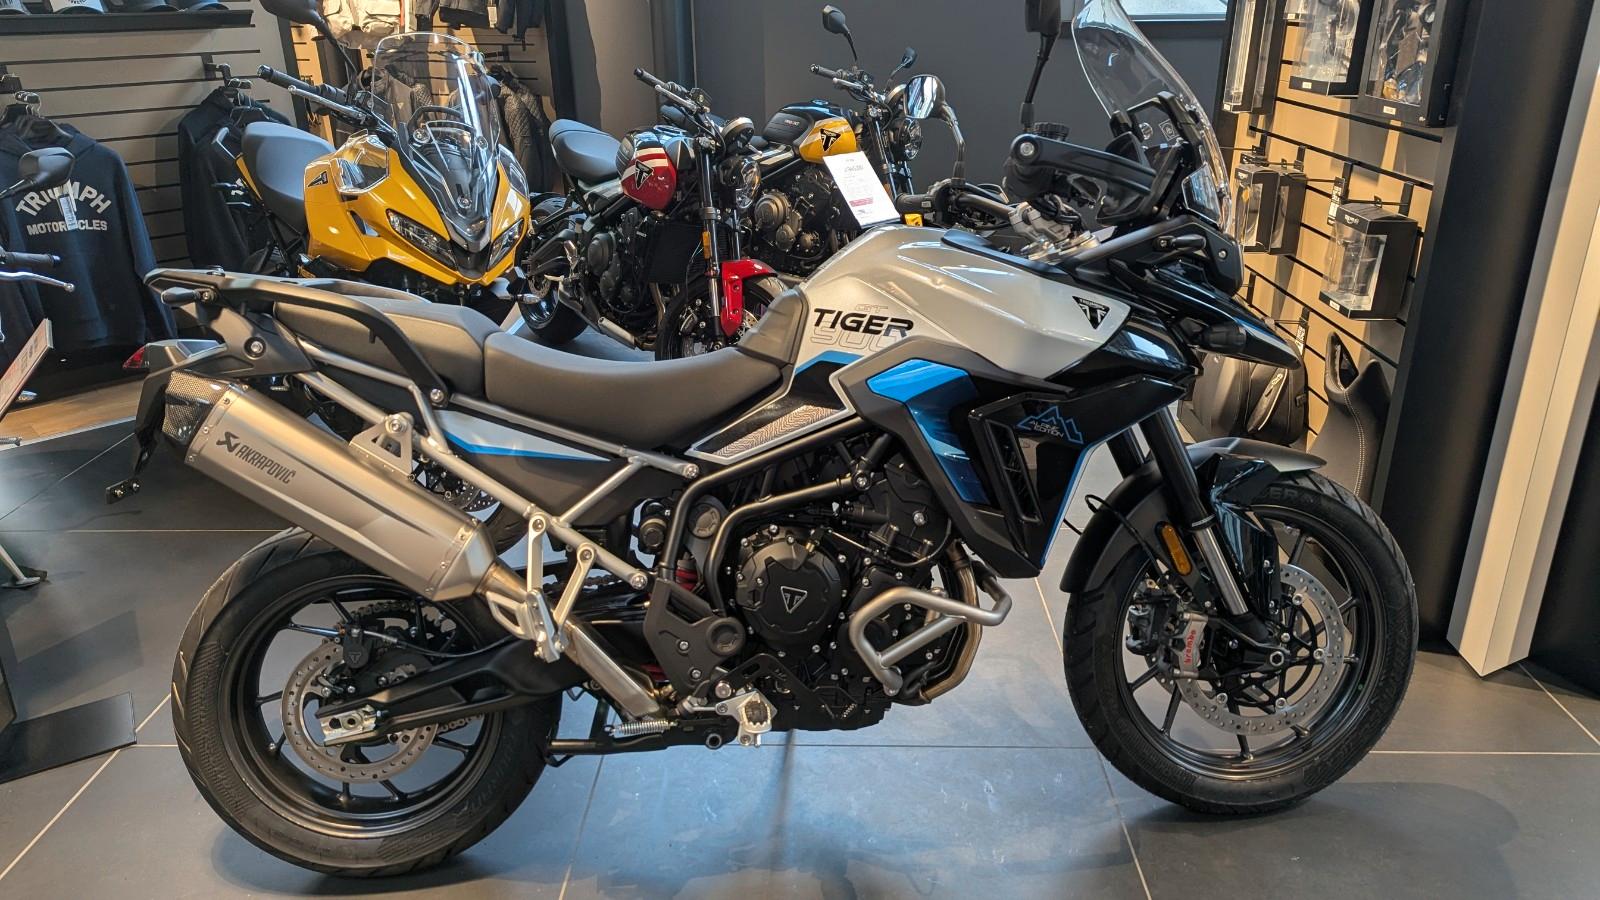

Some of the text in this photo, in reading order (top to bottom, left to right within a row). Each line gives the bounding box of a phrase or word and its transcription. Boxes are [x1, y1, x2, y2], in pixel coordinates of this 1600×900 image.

[26, 219, 108, 236] MOTORCLES
[813, 307, 914, 338] TIGER
[1183, 629, 1197, 665] brembo
